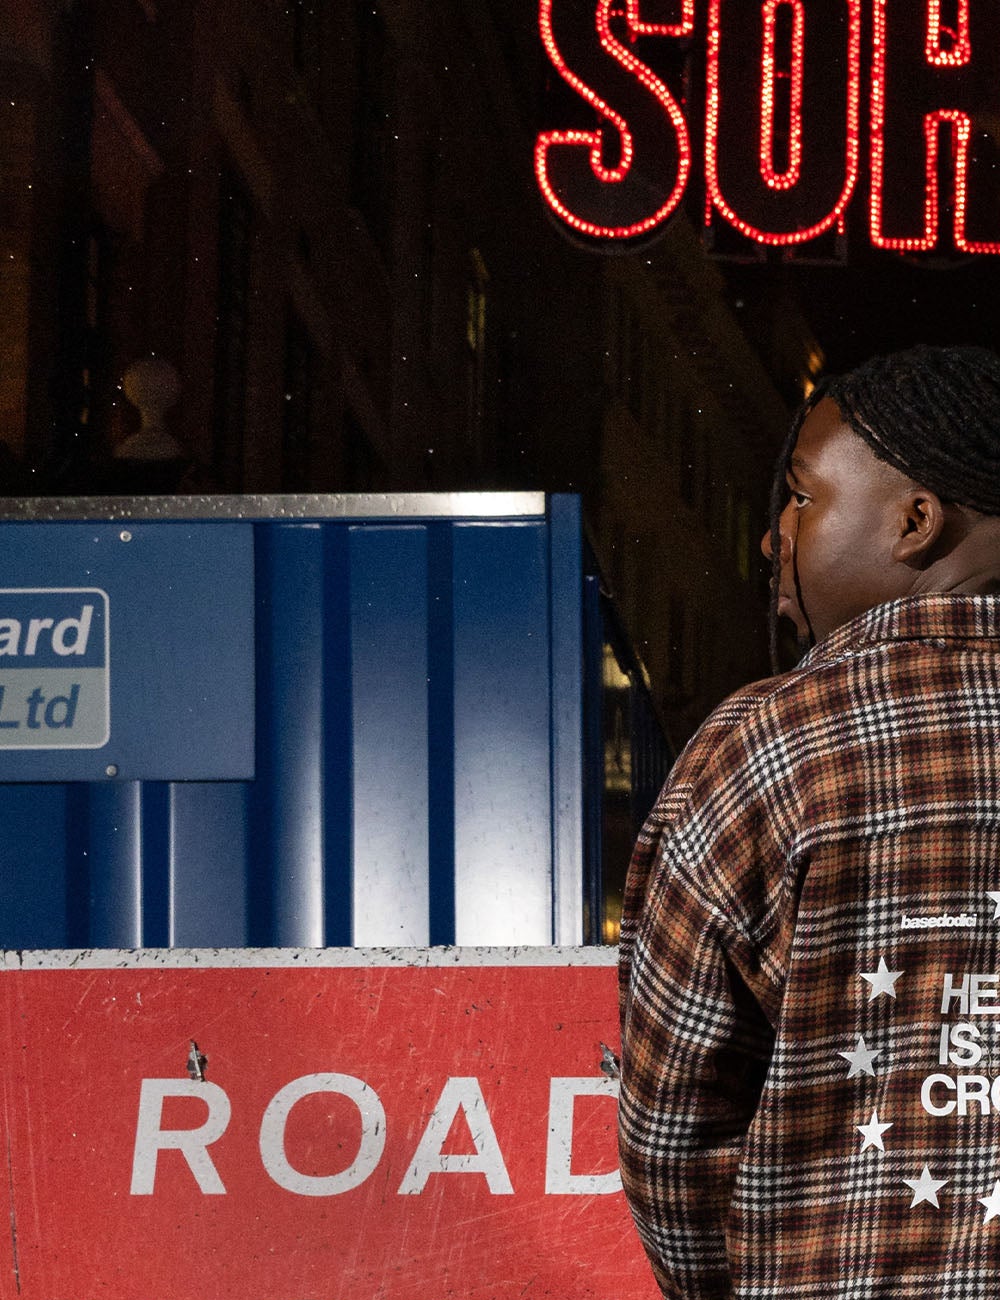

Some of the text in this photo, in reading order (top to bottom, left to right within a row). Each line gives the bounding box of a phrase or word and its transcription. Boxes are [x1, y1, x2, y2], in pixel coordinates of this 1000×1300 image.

[0, 605, 94, 656] ard
[0, 684, 80, 729] Ltd
[939, 1023, 981, 1066] IS
[129, 1072, 626, 1196] ROAD
